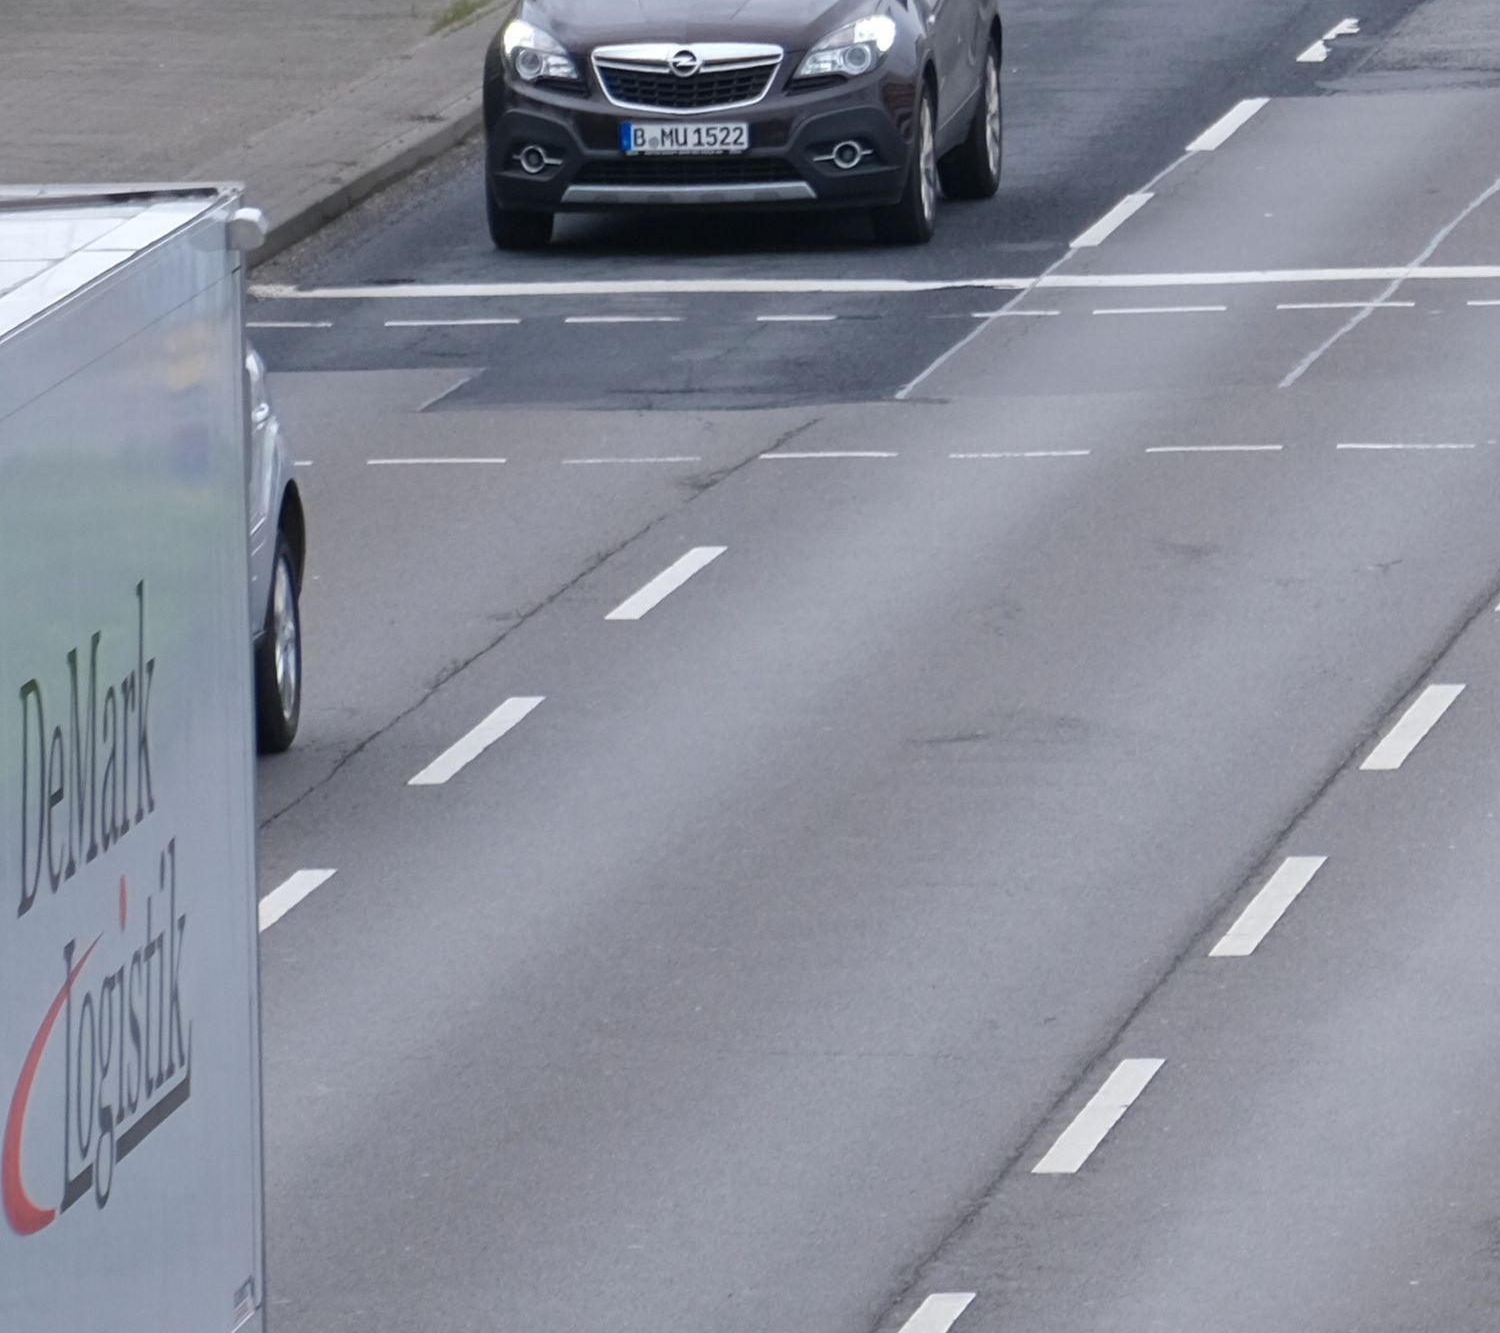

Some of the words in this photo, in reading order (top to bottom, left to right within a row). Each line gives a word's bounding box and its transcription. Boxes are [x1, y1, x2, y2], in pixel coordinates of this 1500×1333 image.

[633, 128, 646, 148] B
[661, 128, 688, 148] MU
[692, 126, 746, 147] 1522
[17, 580, 156, 919] DeMark
